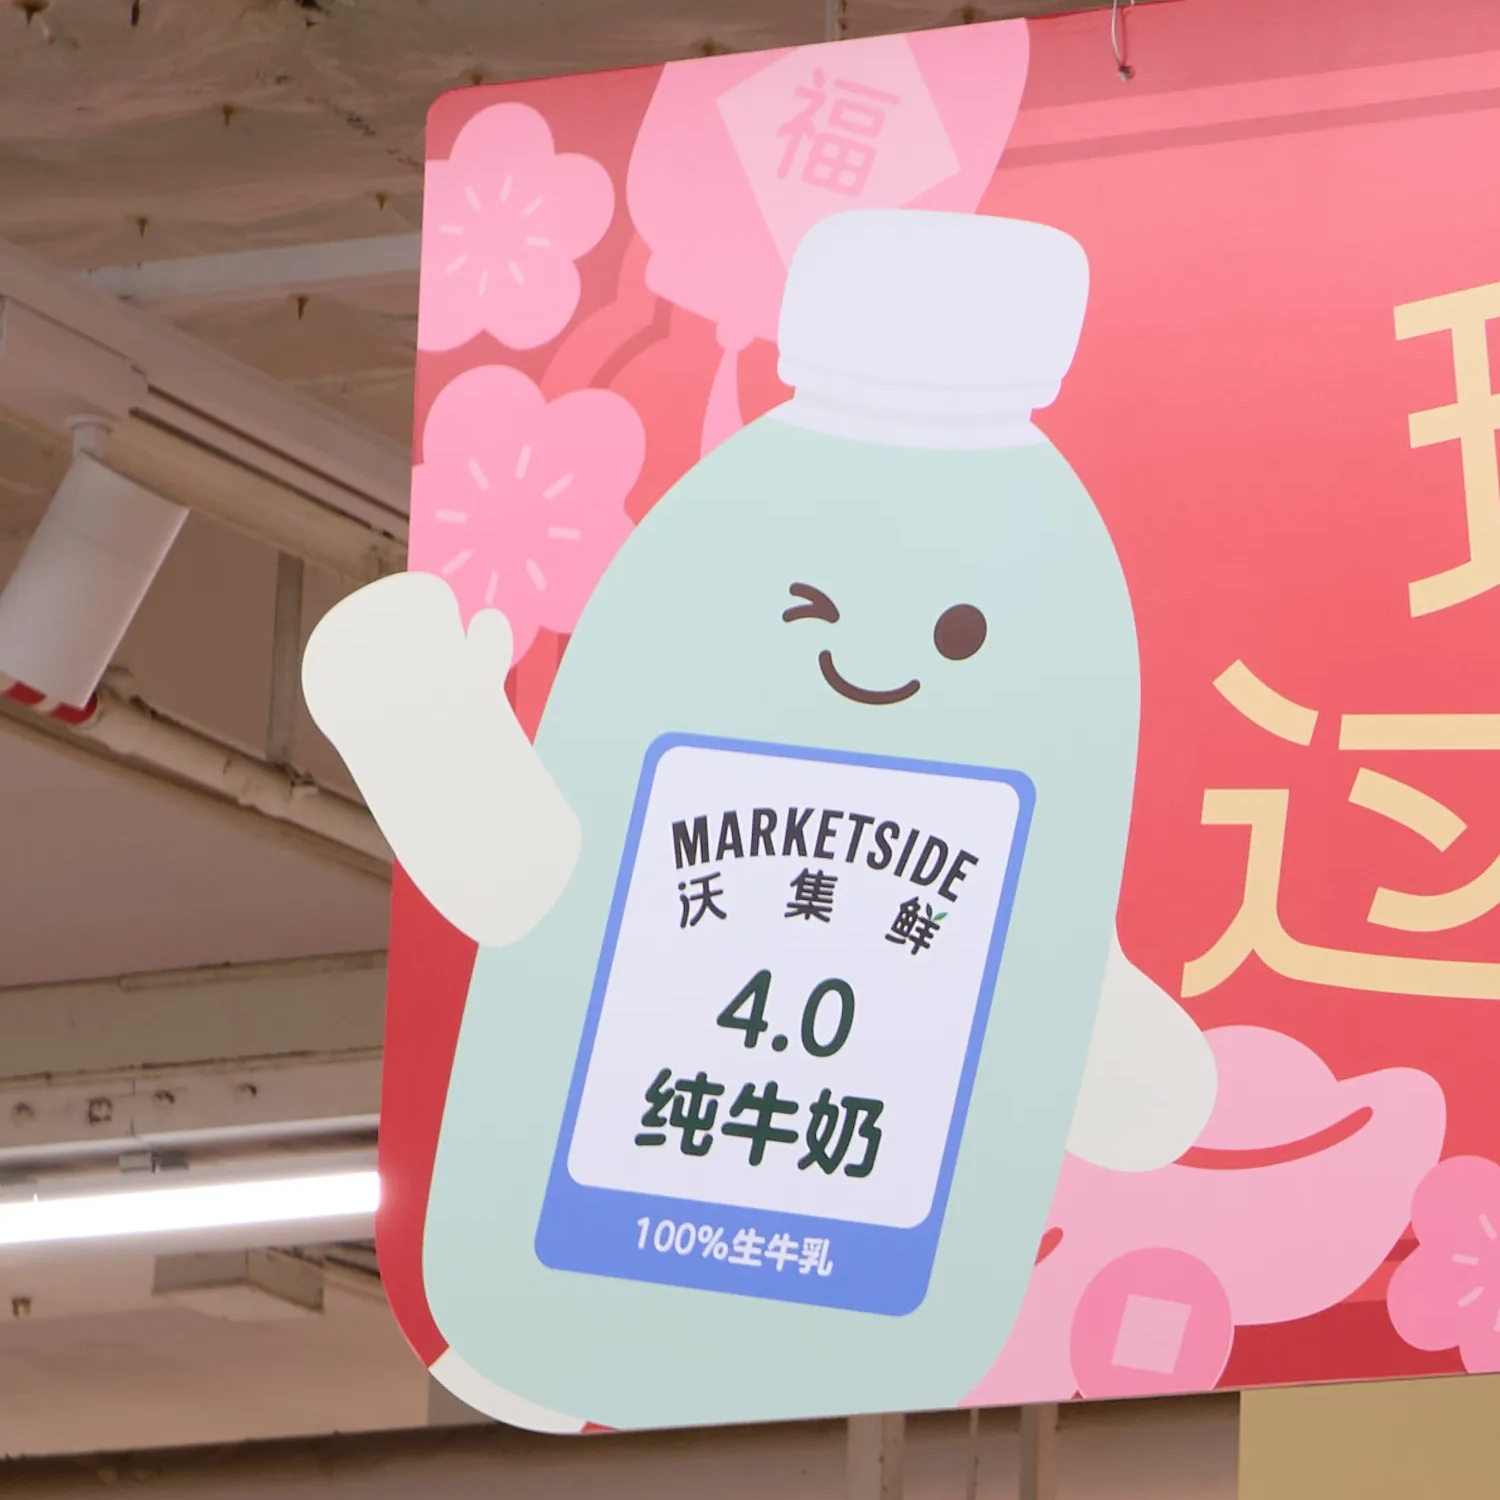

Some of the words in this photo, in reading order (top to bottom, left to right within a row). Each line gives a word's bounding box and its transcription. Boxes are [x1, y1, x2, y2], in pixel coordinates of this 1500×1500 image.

[775, 67, 904, 200] 福
[671, 806, 980, 903] MARKETSIDE
[676, 866, 948, 956] 沃集鲜
[716, 968, 856, 1058] 4.0
[634, 1067, 885, 1179] 纯牛奶
[636, 1216, 834, 1278] 100%生牛乳
